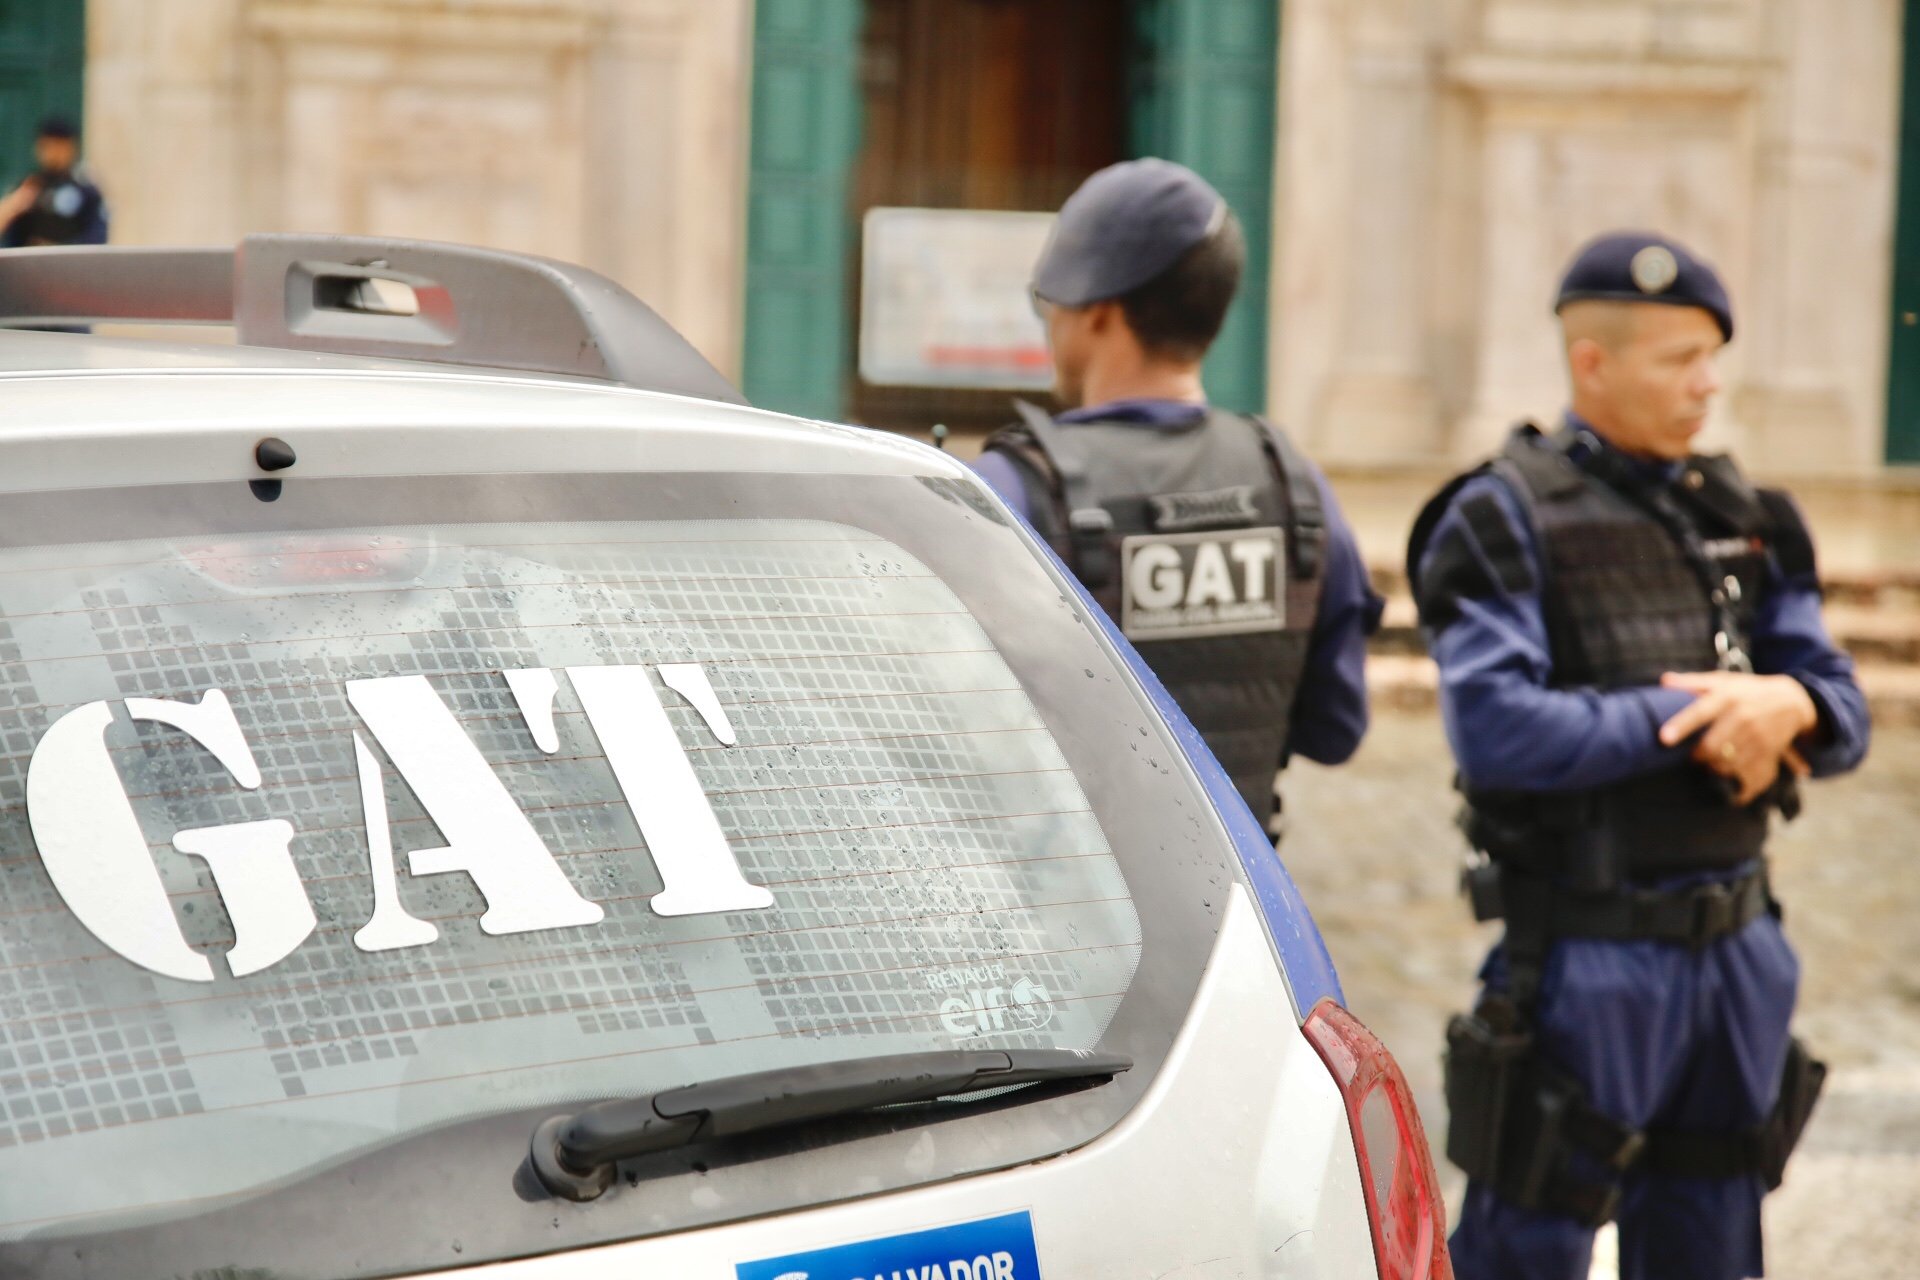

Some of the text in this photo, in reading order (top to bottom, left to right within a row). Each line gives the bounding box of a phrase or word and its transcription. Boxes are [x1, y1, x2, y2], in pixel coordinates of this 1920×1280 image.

[1131, 540, 1273, 608] GAT
[27, 664, 775, 981] GAT
[926, 964, 1006, 990] RENAULT
